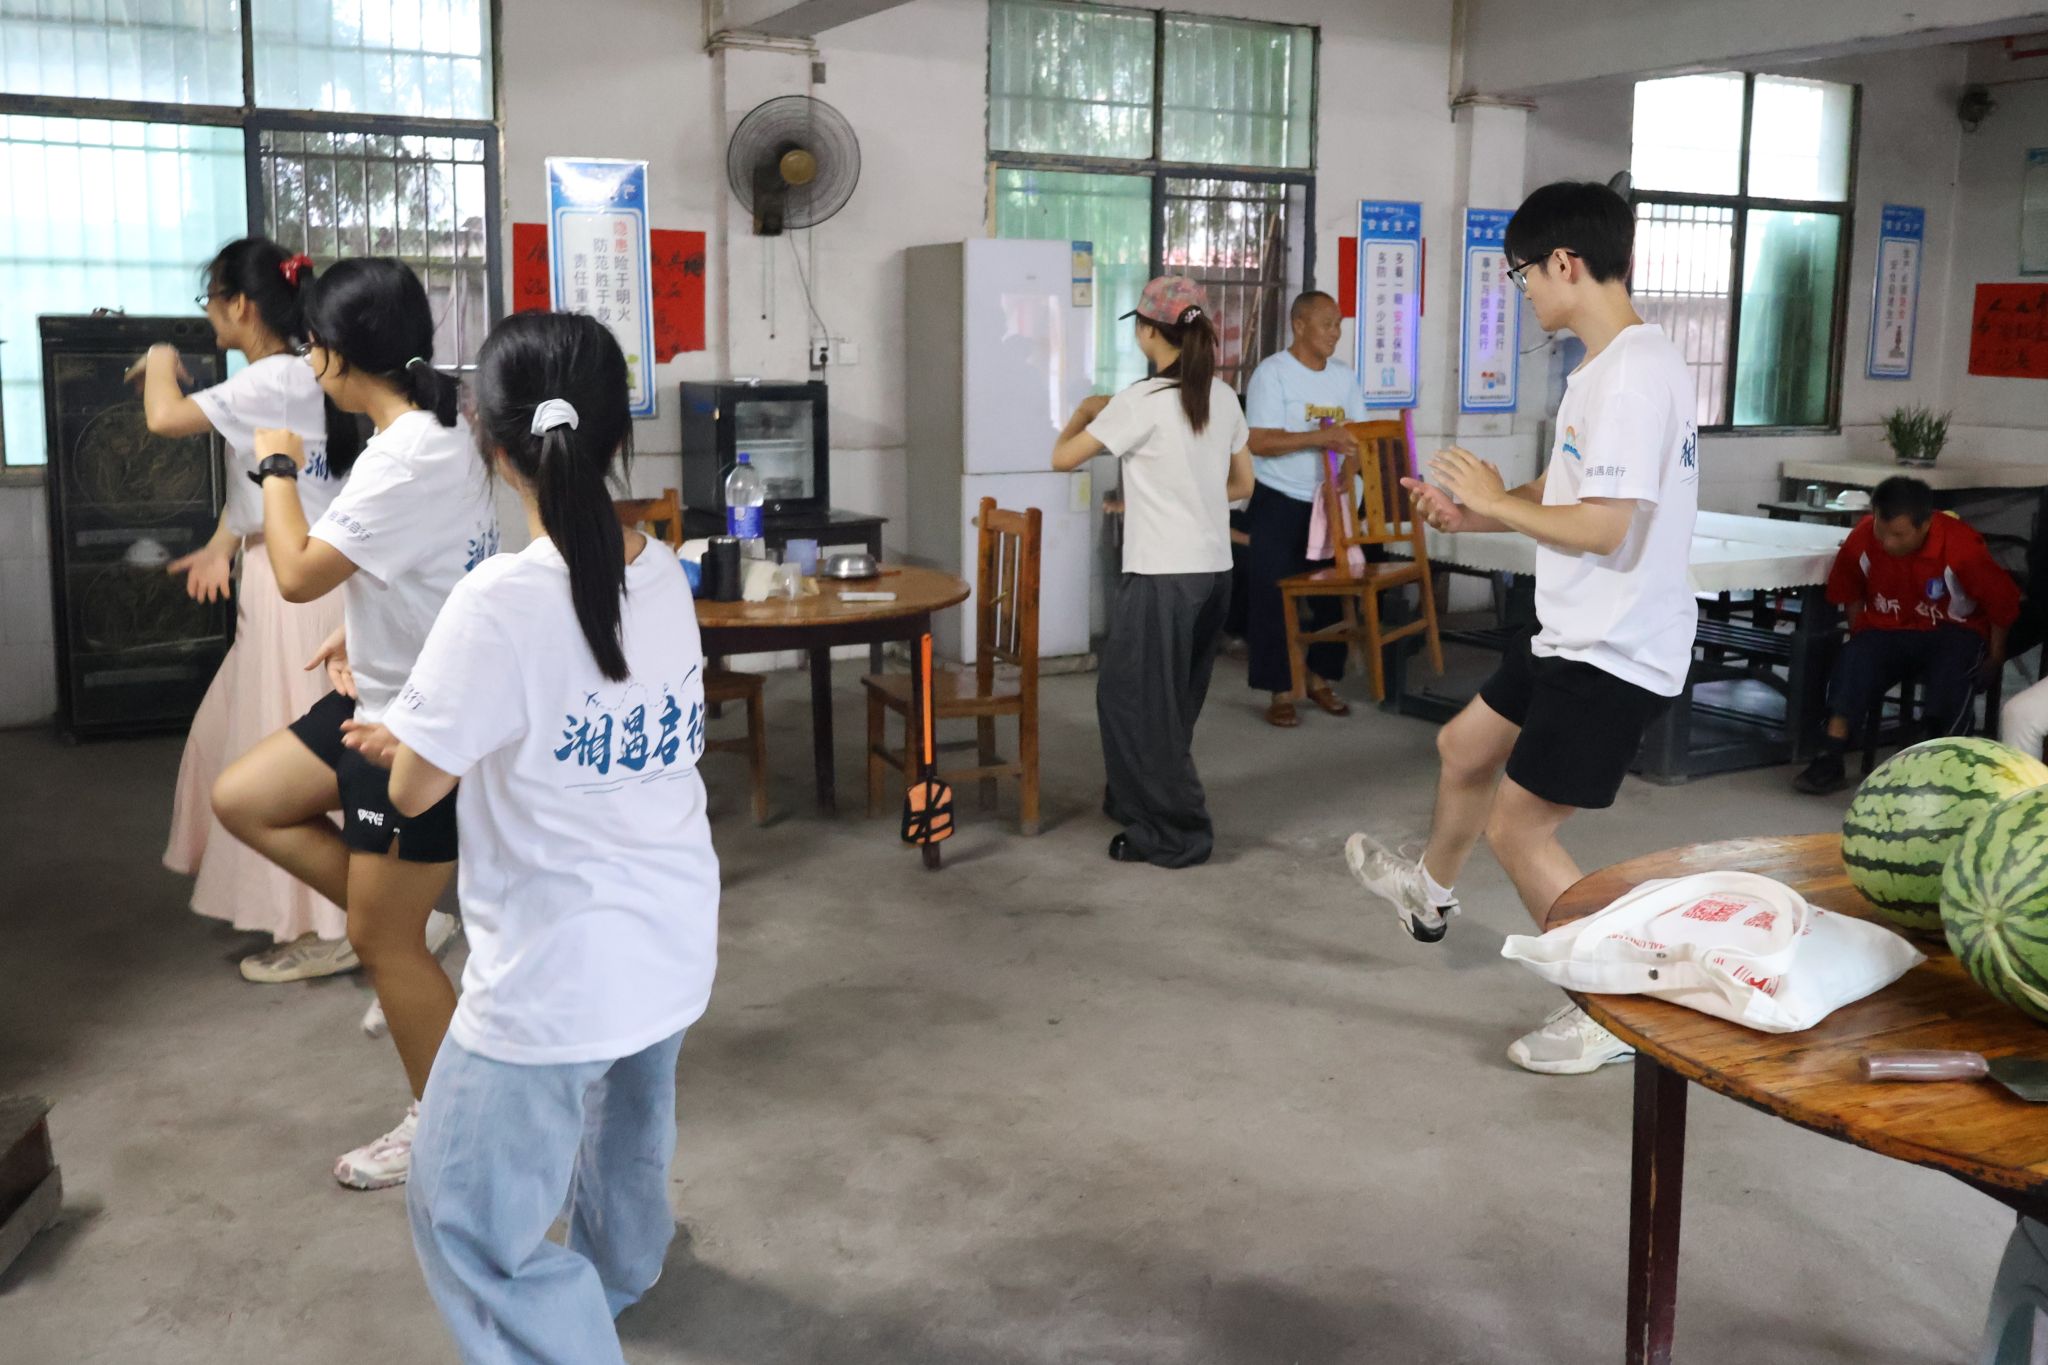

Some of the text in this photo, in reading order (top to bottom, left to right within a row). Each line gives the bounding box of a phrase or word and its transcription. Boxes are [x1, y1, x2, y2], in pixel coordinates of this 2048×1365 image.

[613, 220, 632, 322] 隐患险于明火
